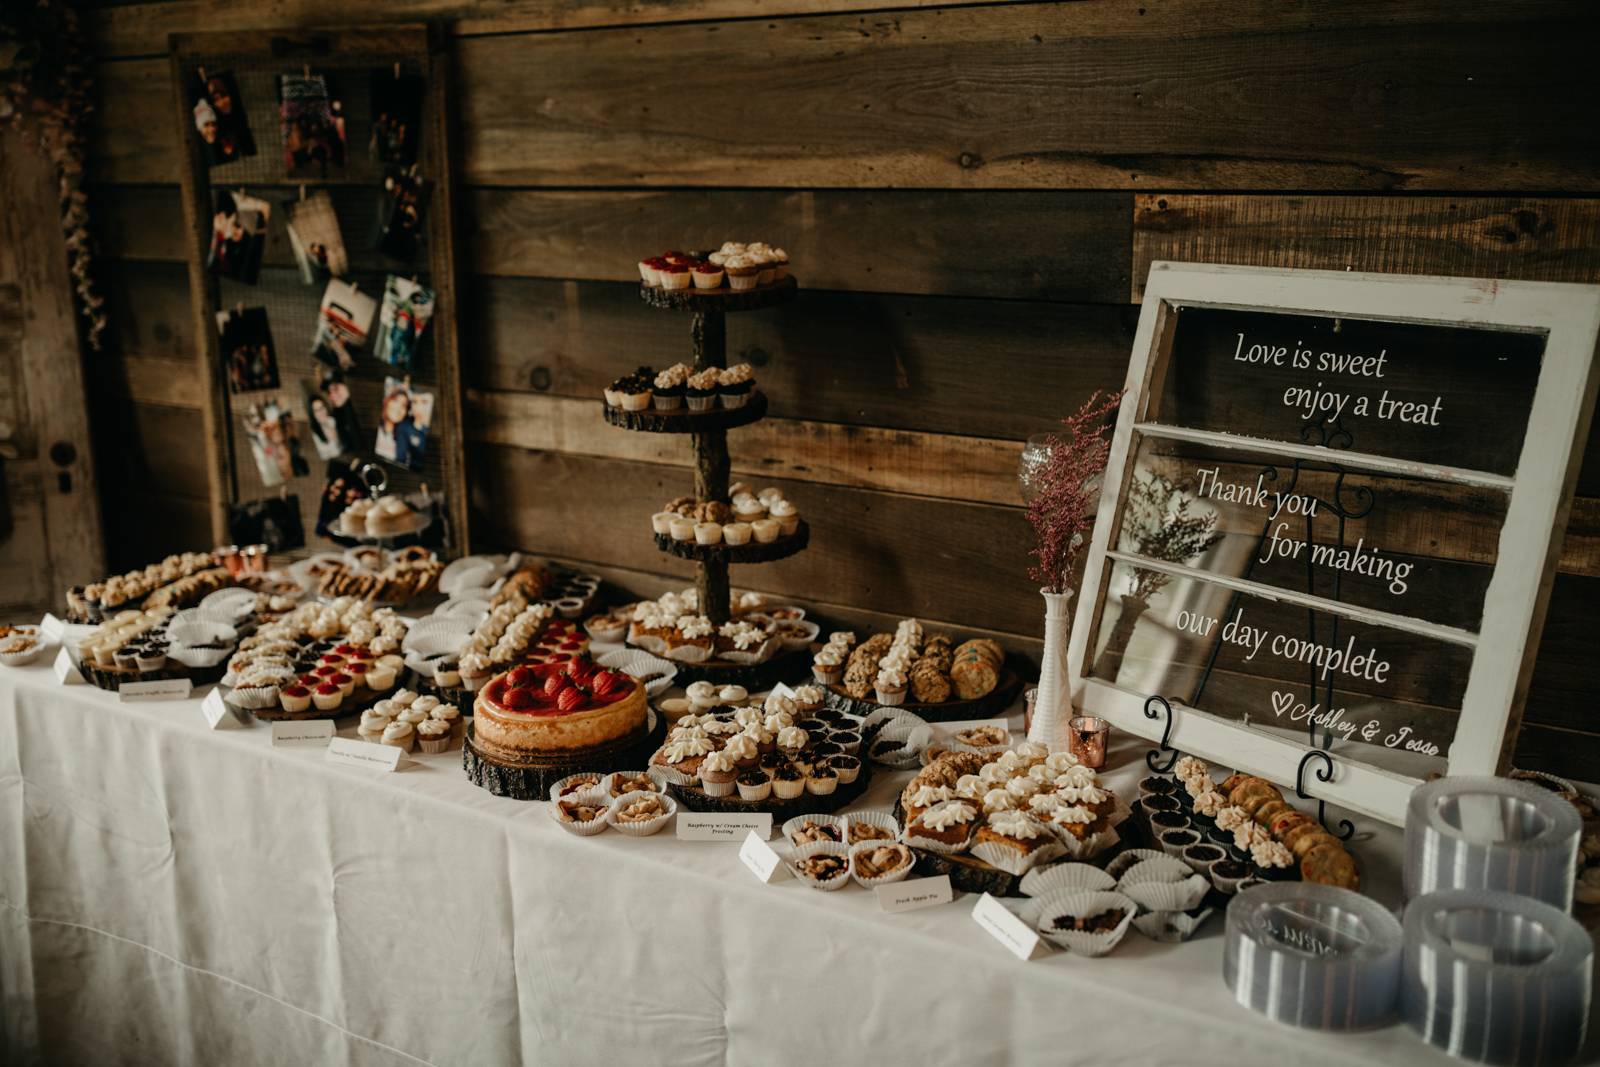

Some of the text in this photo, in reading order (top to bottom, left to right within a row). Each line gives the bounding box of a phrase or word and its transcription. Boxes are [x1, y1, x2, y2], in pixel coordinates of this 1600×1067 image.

[1234, 333, 1387, 378] Love is sweet
[1283, 382, 1443, 426] enjoy a treat
[1196, 468, 1318, 521] Thank you
[1259, 522, 1414, 595] for making
[1176, 608, 1391, 683] our day complete
[1290, 703, 1357, 742] Ashley
[1361, 720, 1380, 741] &
